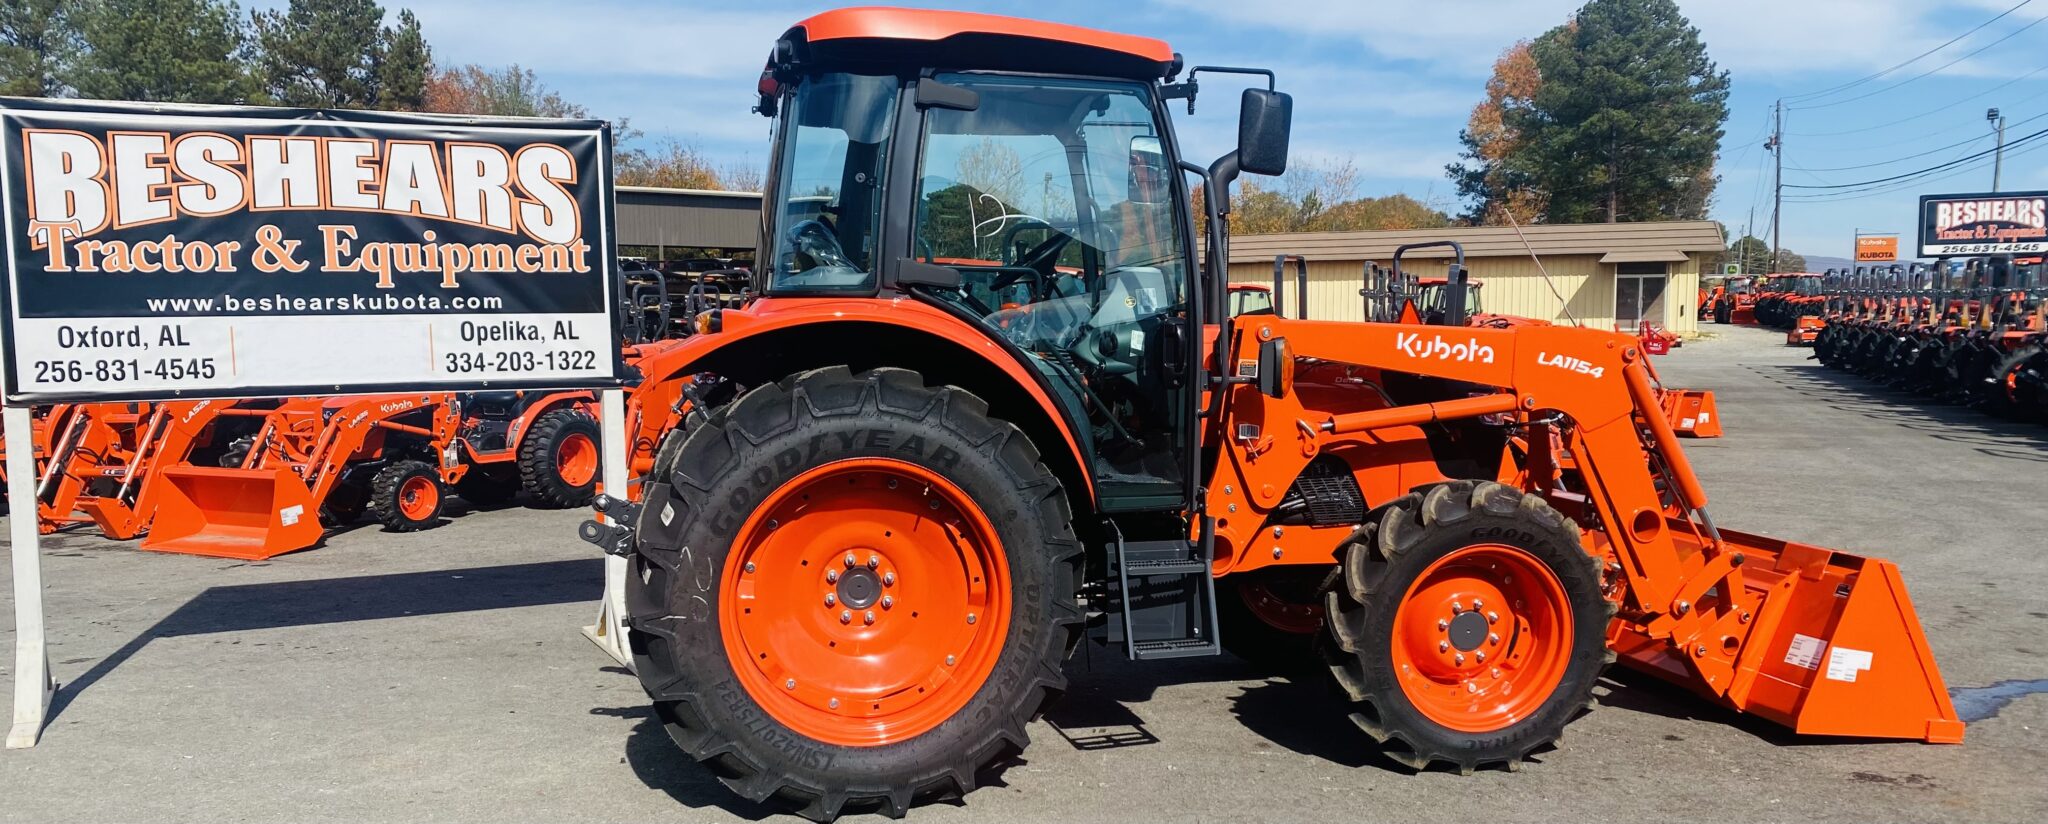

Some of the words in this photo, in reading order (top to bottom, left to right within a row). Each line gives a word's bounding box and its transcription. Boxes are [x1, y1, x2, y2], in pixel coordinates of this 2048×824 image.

[22, 128, 582, 250] BESHEARS
[1936, 200, 2046, 229] BESHEARS
[1936, 227, 1974, 240] Tractor
[1975, 225, 1987, 239] &
[1989, 225, 2047, 243] Equipment
[28, 218, 238, 273] Tractor
[251, 224, 309, 273] &
[319, 224, 591, 288] Equipment
[1860, 251, 1895, 259] KUBOTA
[1942, 244, 2040, 254] 256-831-4545
[147, 294, 502, 312] www.beshearskubota.com
[58, 325, 149, 350] Oxford,
[159, 324, 190, 347] AL
[460, 321, 545, 345] Opelika,
[552, 321, 580, 341] AL
[1396, 332, 1494, 363] Kubota
[34, 358, 216, 383] 256-831-4545
[445, 350, 596, 373] 334-203-1322
[1537, 351, 1604, 378] LA1154
[381, 400, 413, 413] Kubota
[711, 429, 960, 540] GOODYEAR
